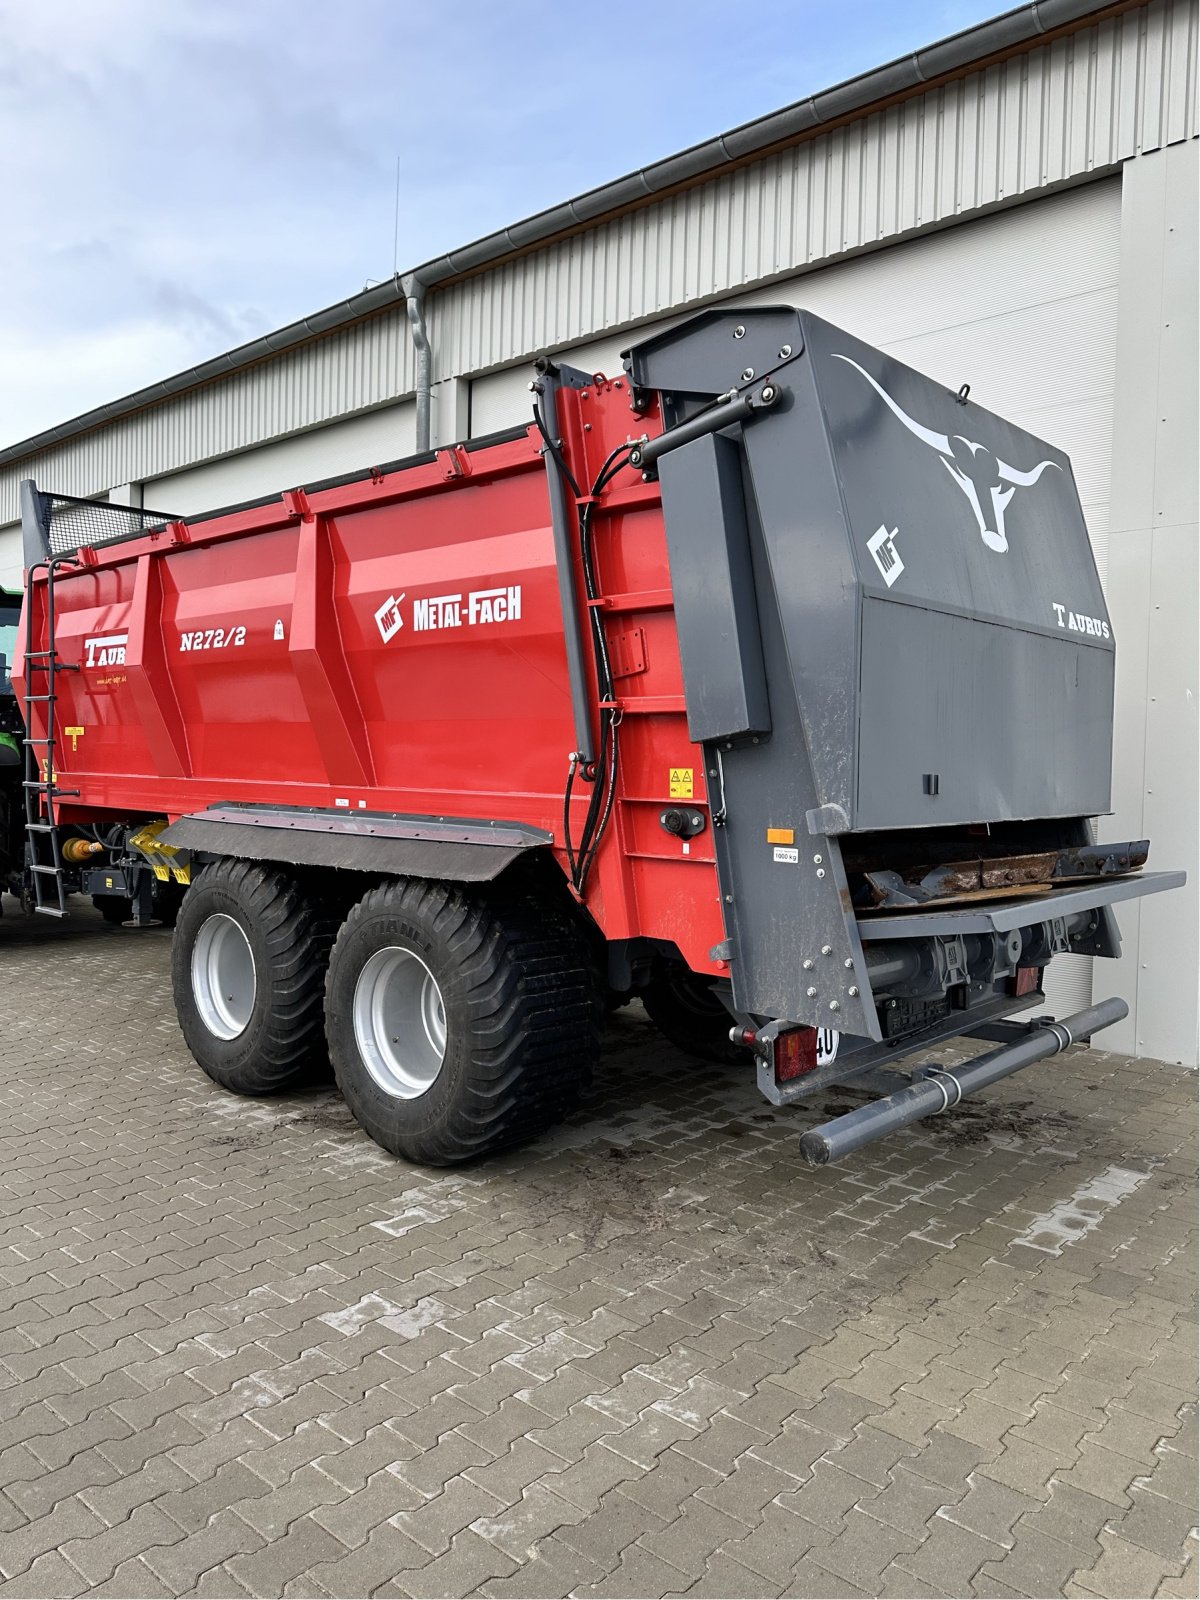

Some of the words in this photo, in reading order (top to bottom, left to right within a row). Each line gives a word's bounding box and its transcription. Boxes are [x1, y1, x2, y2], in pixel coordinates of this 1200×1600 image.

[413, 586, 521, 631] METAL-FACH
[1052, 602, 1110, 639] TAURUS
[179, 626, 247, 652] N272/2
[775, 852, 789, 860] 1000
[789, 853, 797, 862] kg
